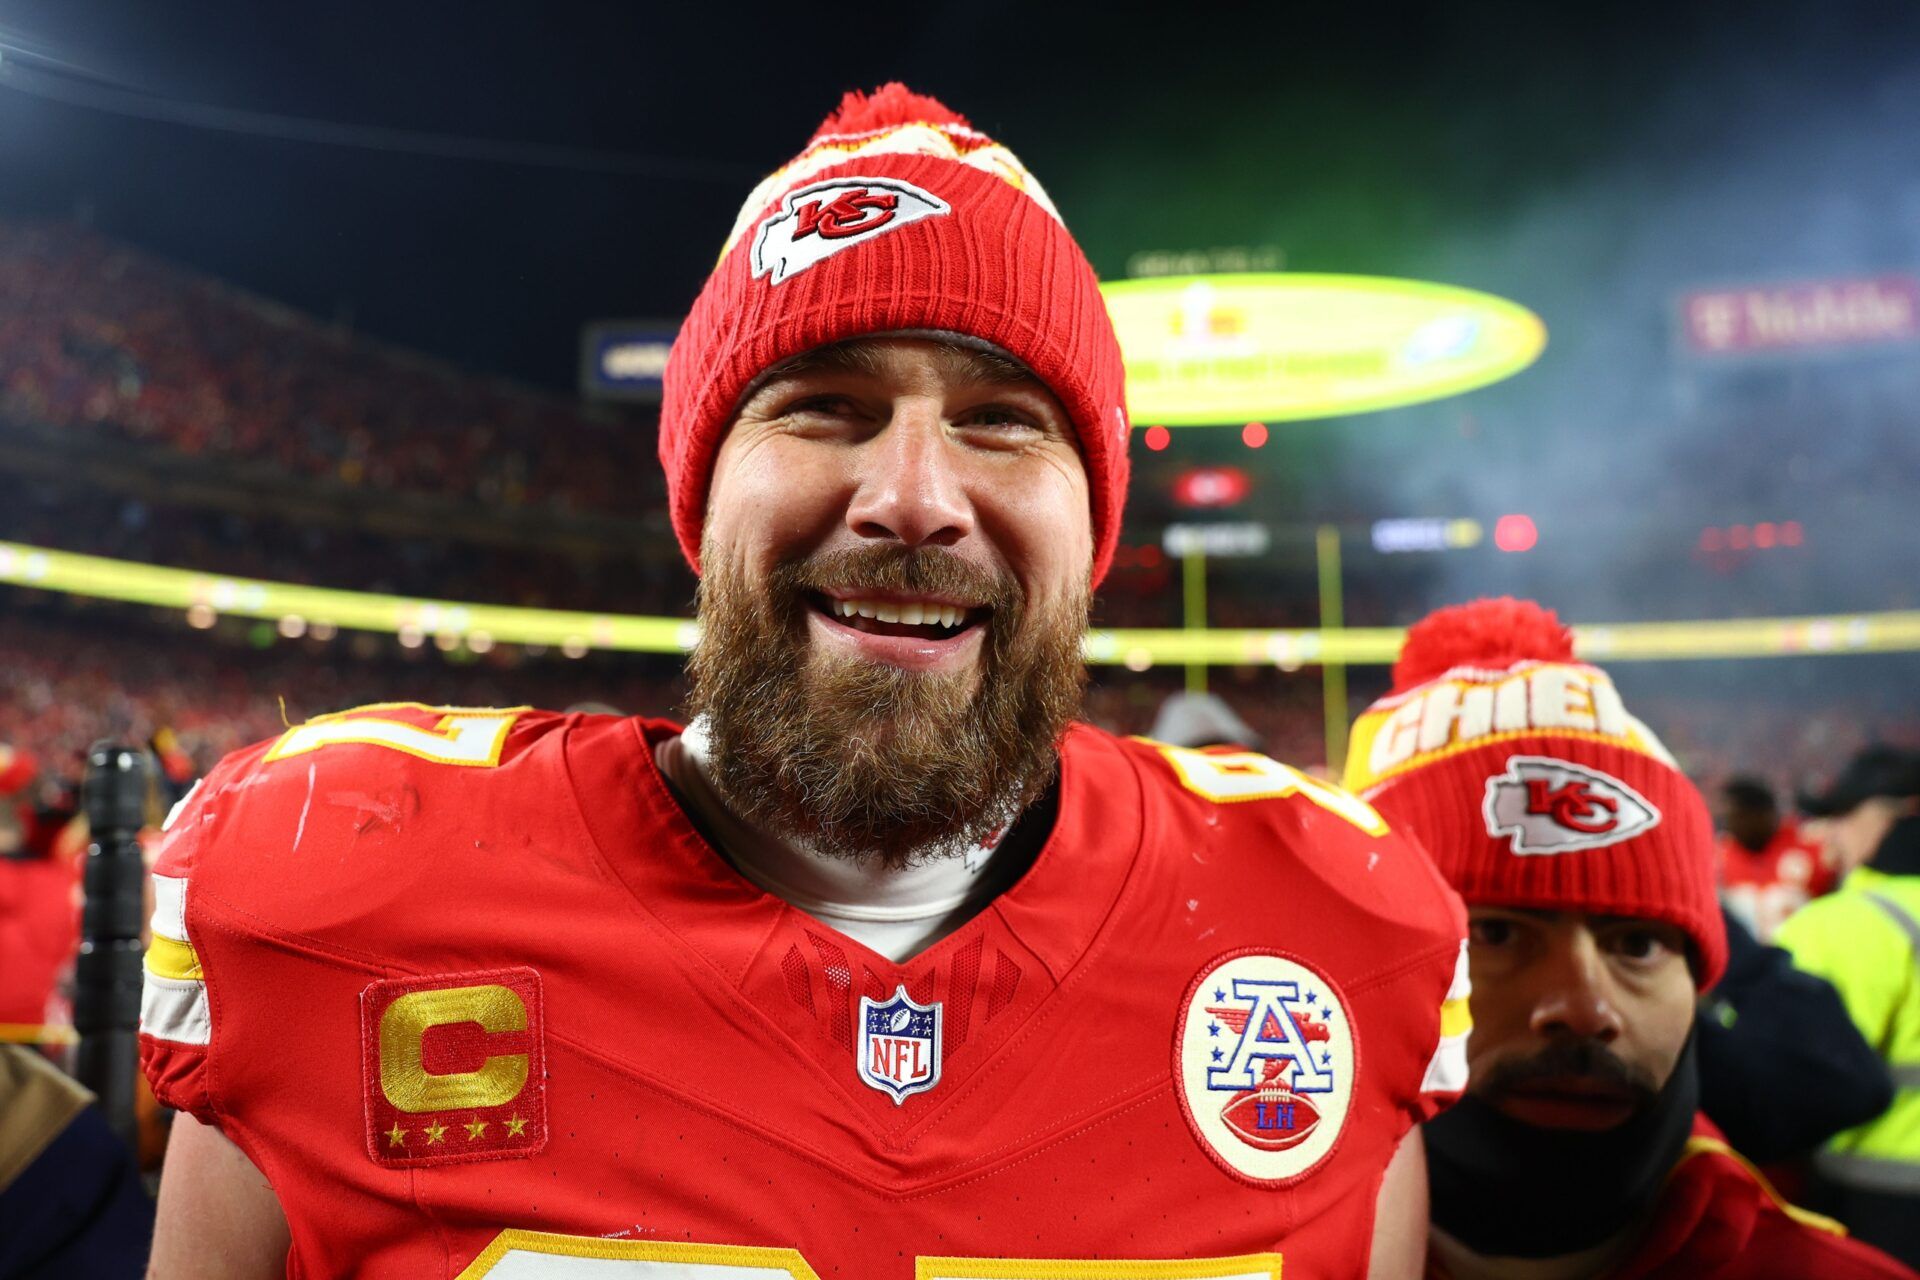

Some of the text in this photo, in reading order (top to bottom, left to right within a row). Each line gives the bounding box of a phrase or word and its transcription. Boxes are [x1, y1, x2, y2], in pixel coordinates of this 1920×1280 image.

[791, 188, 899, 242] KC
[1524, 780, 1618, 834] KC
[379, 984, 529, 1114] C
[872, 1037, 927, 1082] NFL
[1206, 978, 1334, 1093] A
[1255, 1103, 1295, 1130] LH
